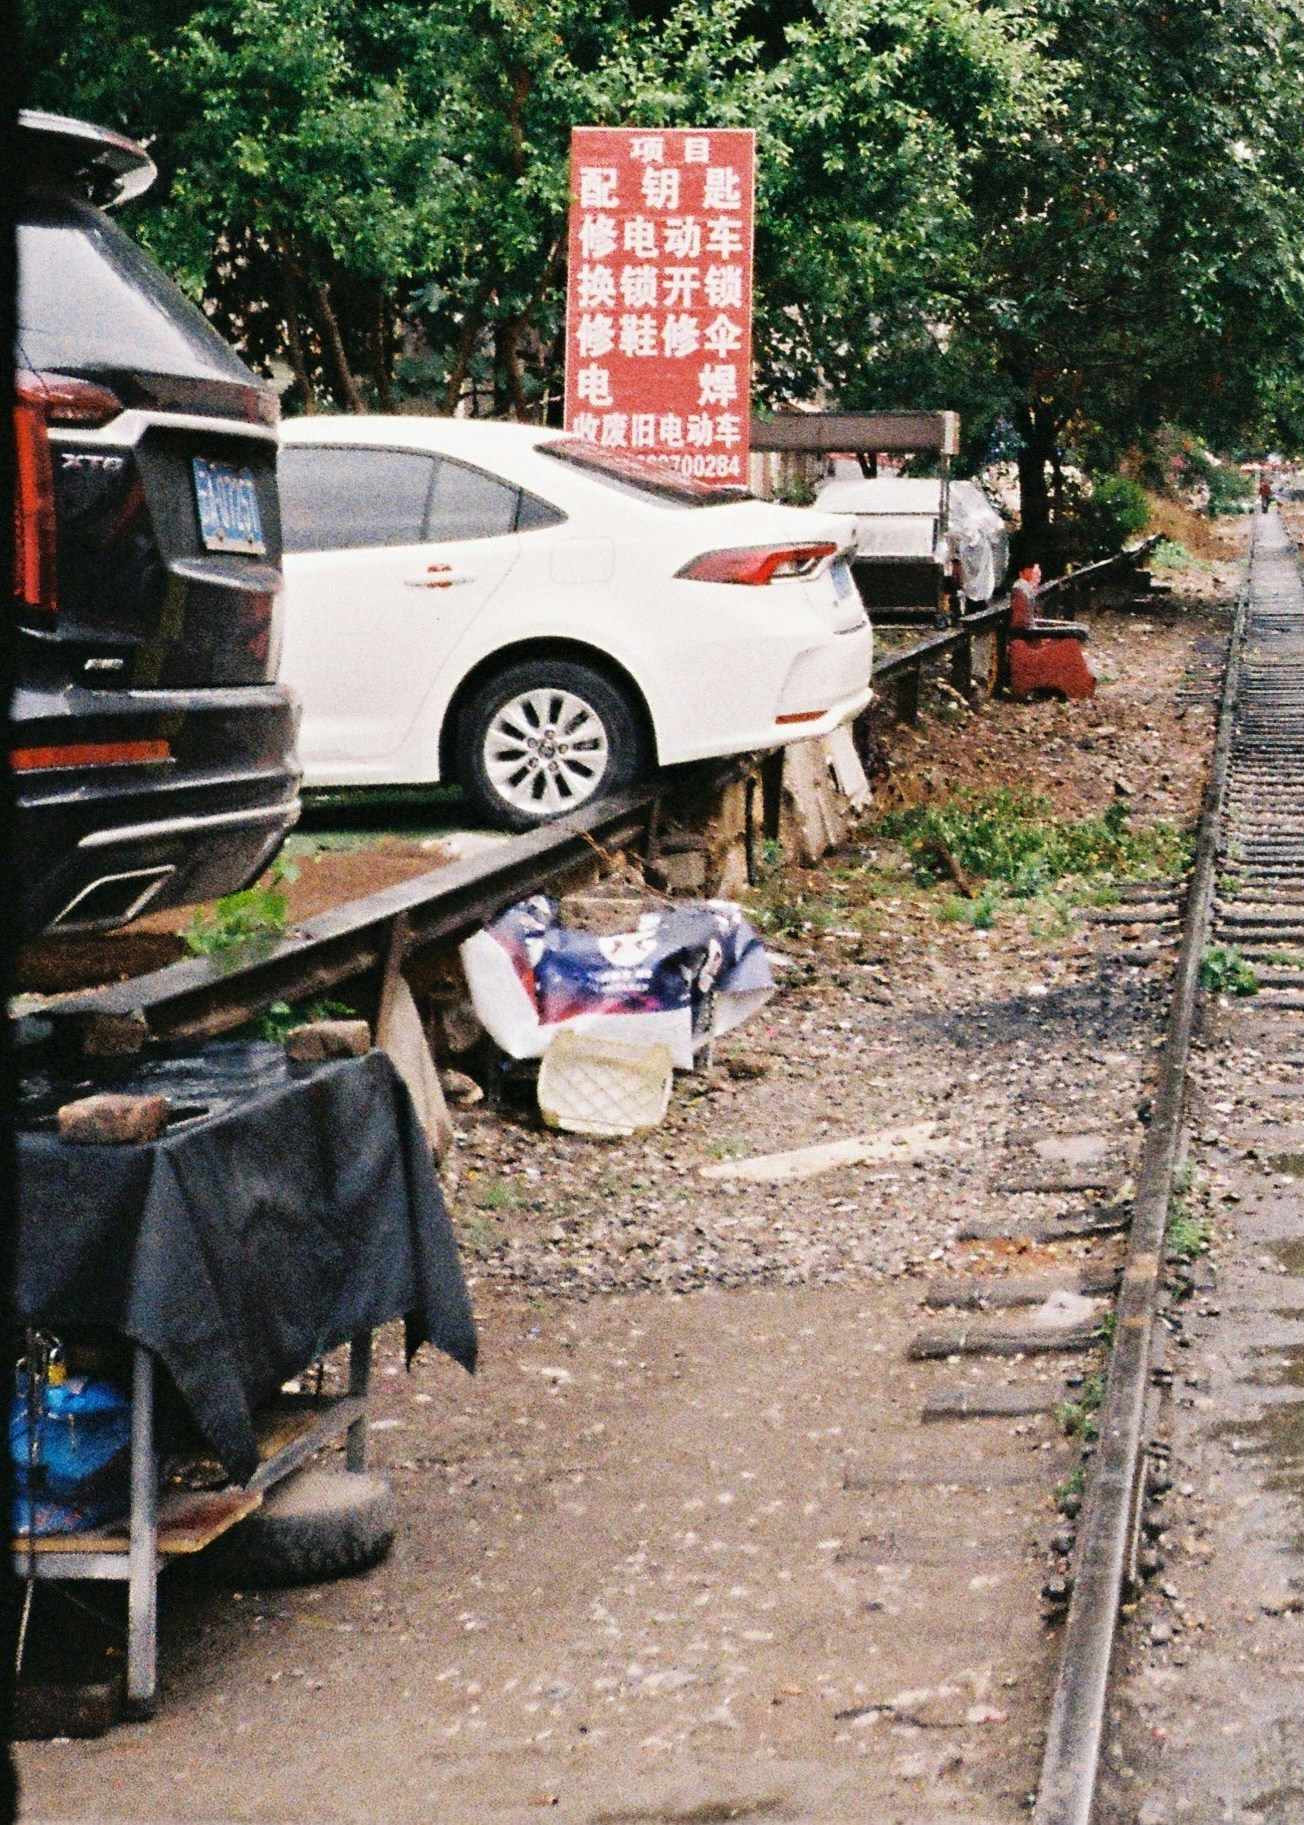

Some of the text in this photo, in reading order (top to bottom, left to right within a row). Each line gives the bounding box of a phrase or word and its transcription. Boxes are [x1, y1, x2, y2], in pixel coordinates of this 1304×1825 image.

[629, 137, 711, 163] 项目
[579, 167, 741, 210] 配钥匙
[578, 215, 743, 261] 修电动车
[577, 265, 742, 309] 换锁开锁
[575, 313, 742, 358] 修鞋修伞
[576, 362, 738, 407] 电焊
[573, 412, 742, 450] 收废旧电动车
